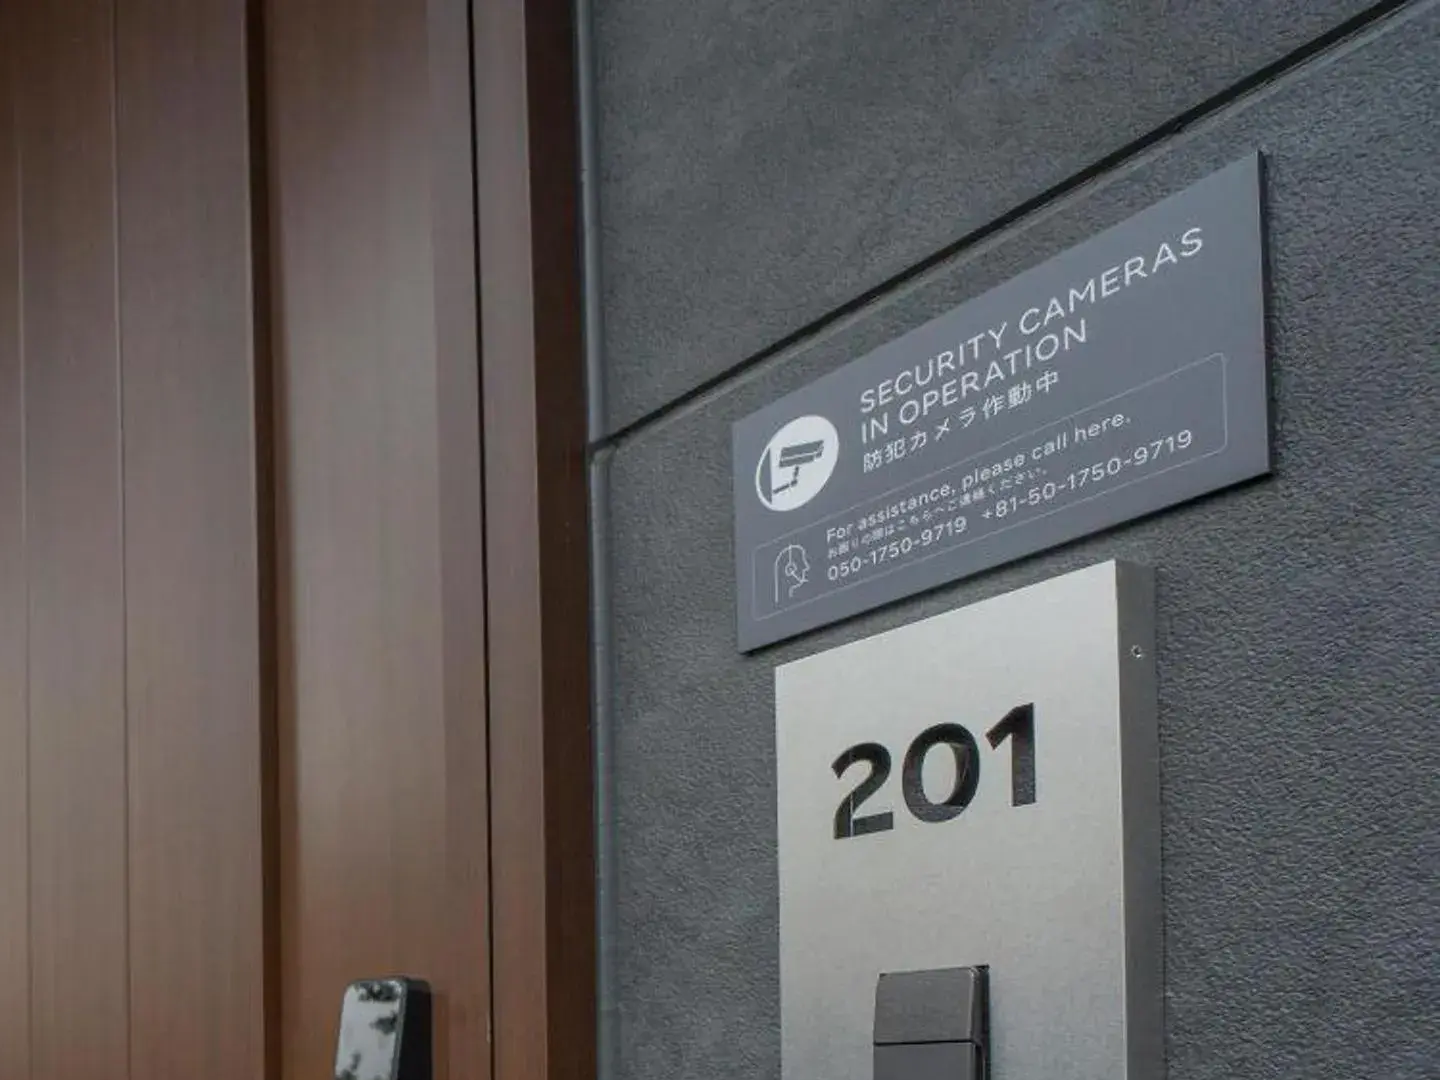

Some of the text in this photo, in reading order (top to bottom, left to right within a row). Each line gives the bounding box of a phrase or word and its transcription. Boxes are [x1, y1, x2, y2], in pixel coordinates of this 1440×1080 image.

[860, 226, 1203, 413] SECURITY CAMERAS
[861, 315, 1087, 445] IN OPERATION
[826, 411, 1131, 543] For assistance, please call here.
[862, 365, 1059, 474] 防犯カメラ作動中
[827, 427, 1192, 582] 050-1750-9719 +81-50-1750-9719
[831, 702, 1036, 840] 201
